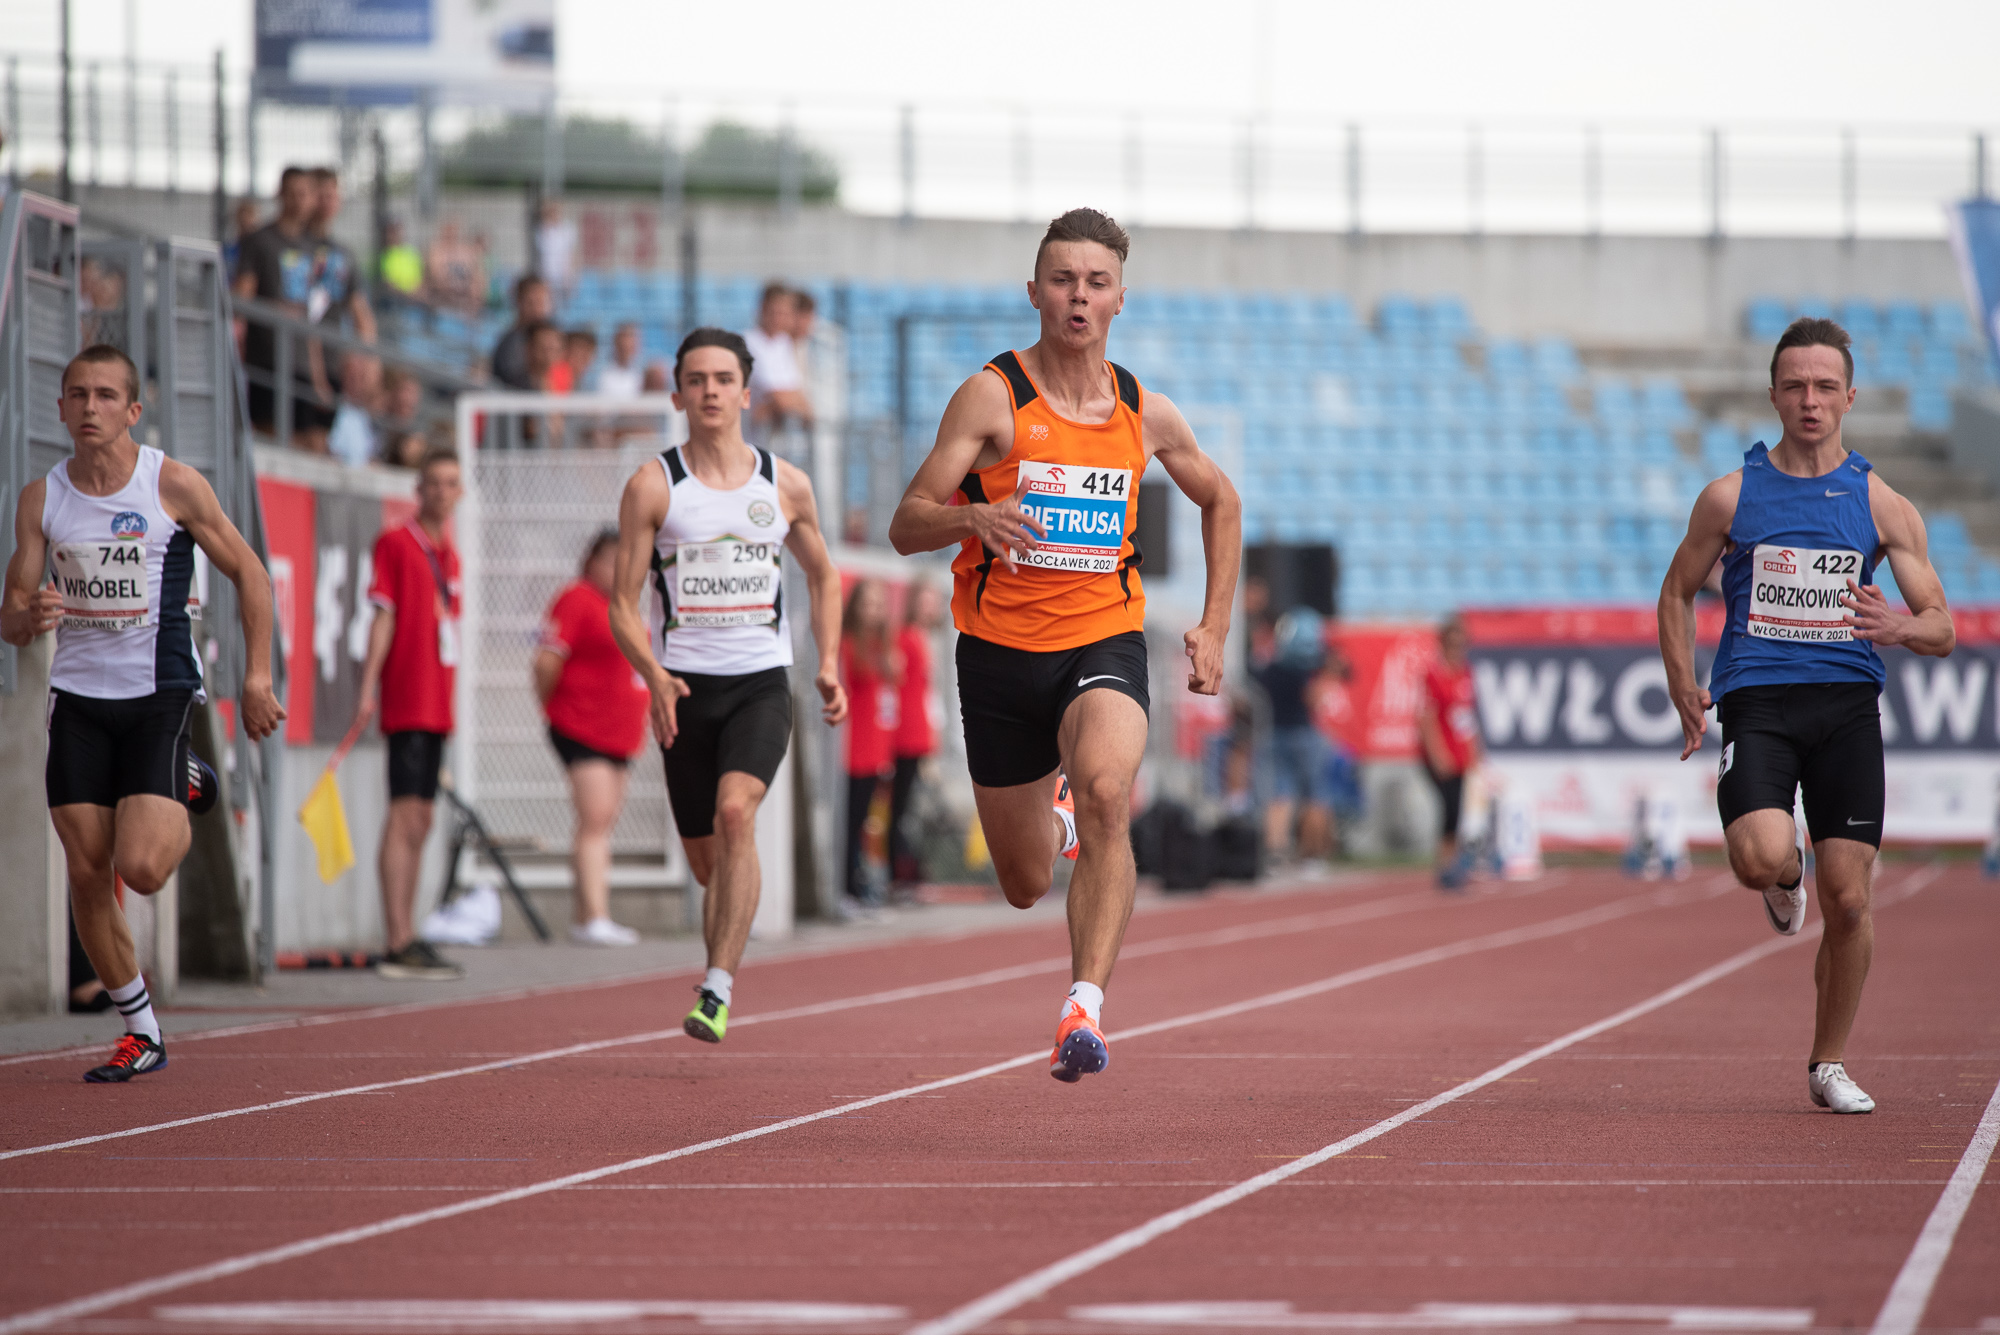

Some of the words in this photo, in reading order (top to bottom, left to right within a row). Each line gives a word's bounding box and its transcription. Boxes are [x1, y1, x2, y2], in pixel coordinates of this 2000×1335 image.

[1030, 481, 1065, 493] ORLEN
[1082, 472, 1125, 496] 414
[98, 546, 140, 567] 744
[733, 544, 768, 563] 250
[1765, 563, 1795, 574] ORLEN
[1812, 554, 1857, 575] 422
[63, 576, 142, 599] WRÓBEL
[1753, 624, 1824, 640] WŁOCŁAWEK
[1826, 629, 1848, 640] 2021
